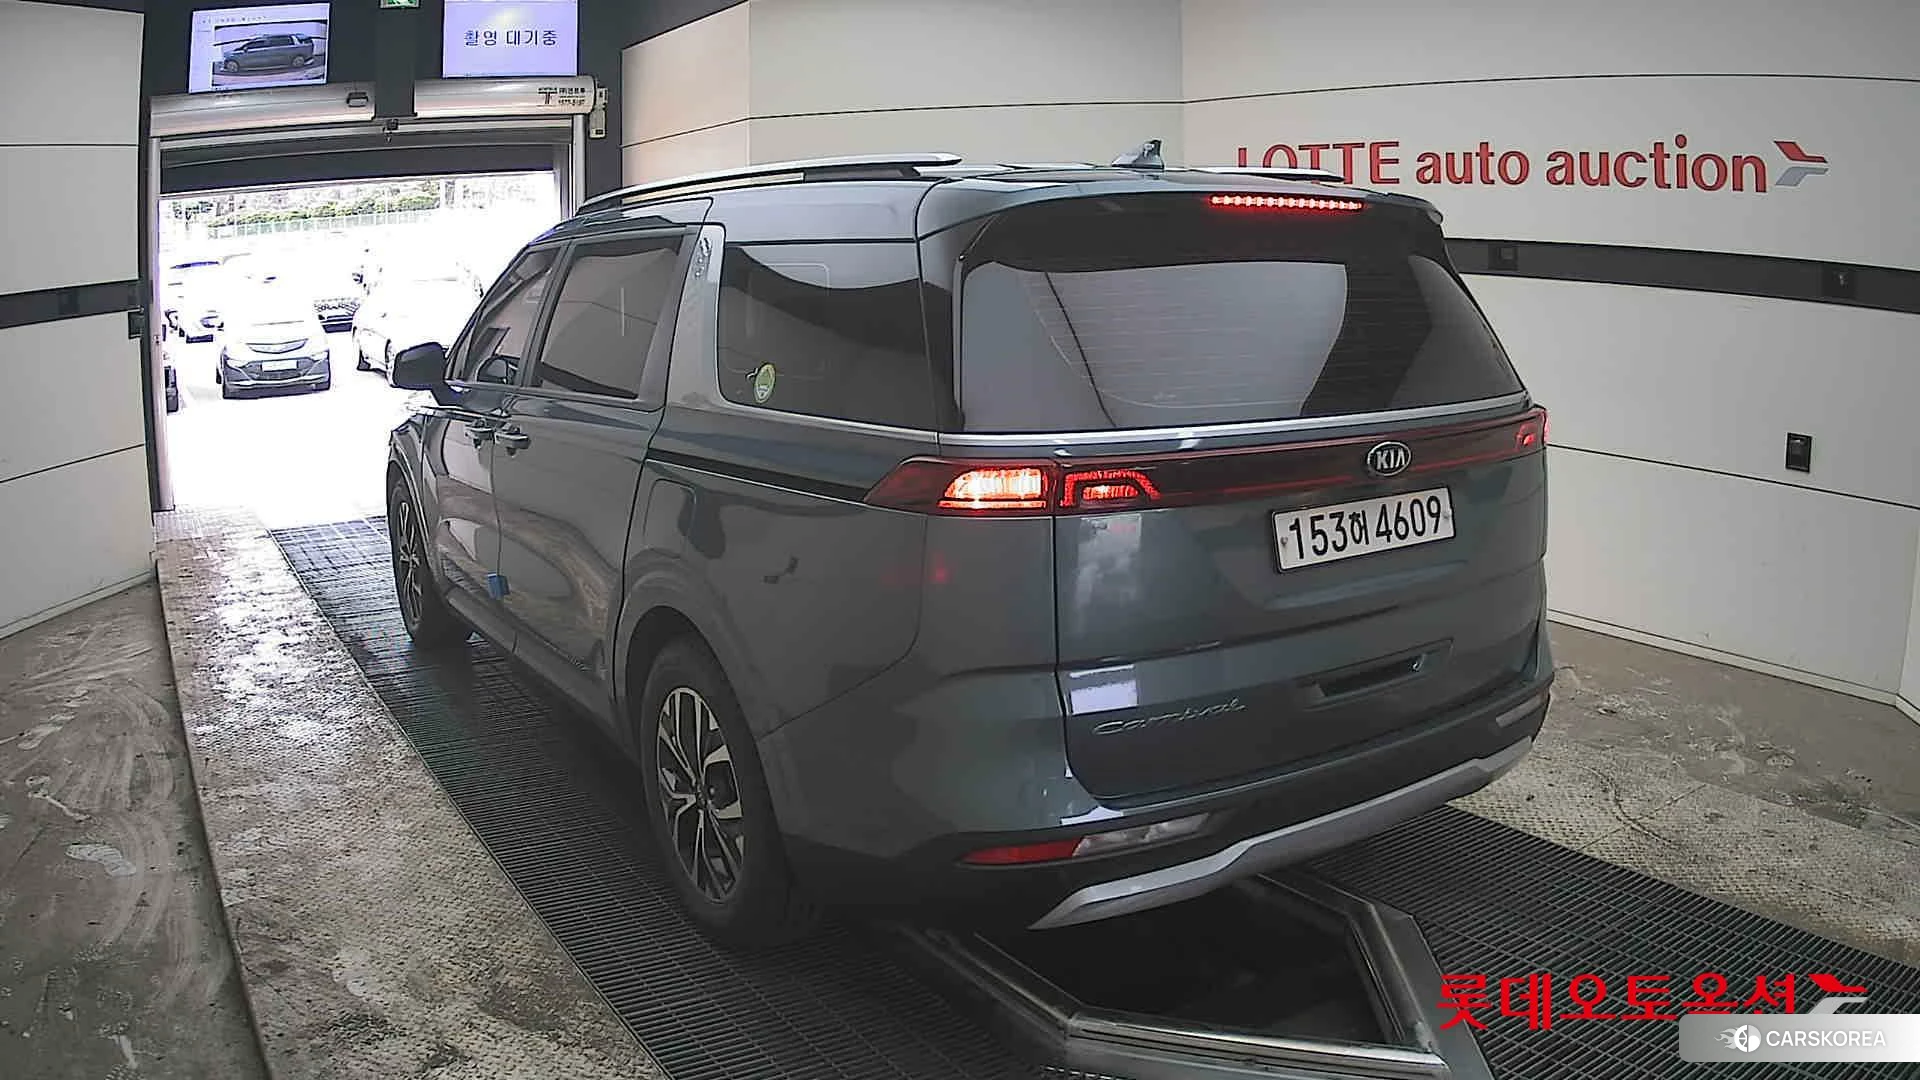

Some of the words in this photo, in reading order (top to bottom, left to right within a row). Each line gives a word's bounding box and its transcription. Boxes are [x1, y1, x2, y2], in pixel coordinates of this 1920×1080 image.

[463, 29, 498, 47] 촬영
[505, 29, 558, 47] 대기중
[1415, 141, 1531, 186] auto
[1546, 134, 1768, 194] auction
[1375, 449, 1407, 471] KIA
[1288, 509, 1371, 560] 153허
[1375, 495, 1442, 545] 4609
[1091, 697, 1248, 736] Carnival
